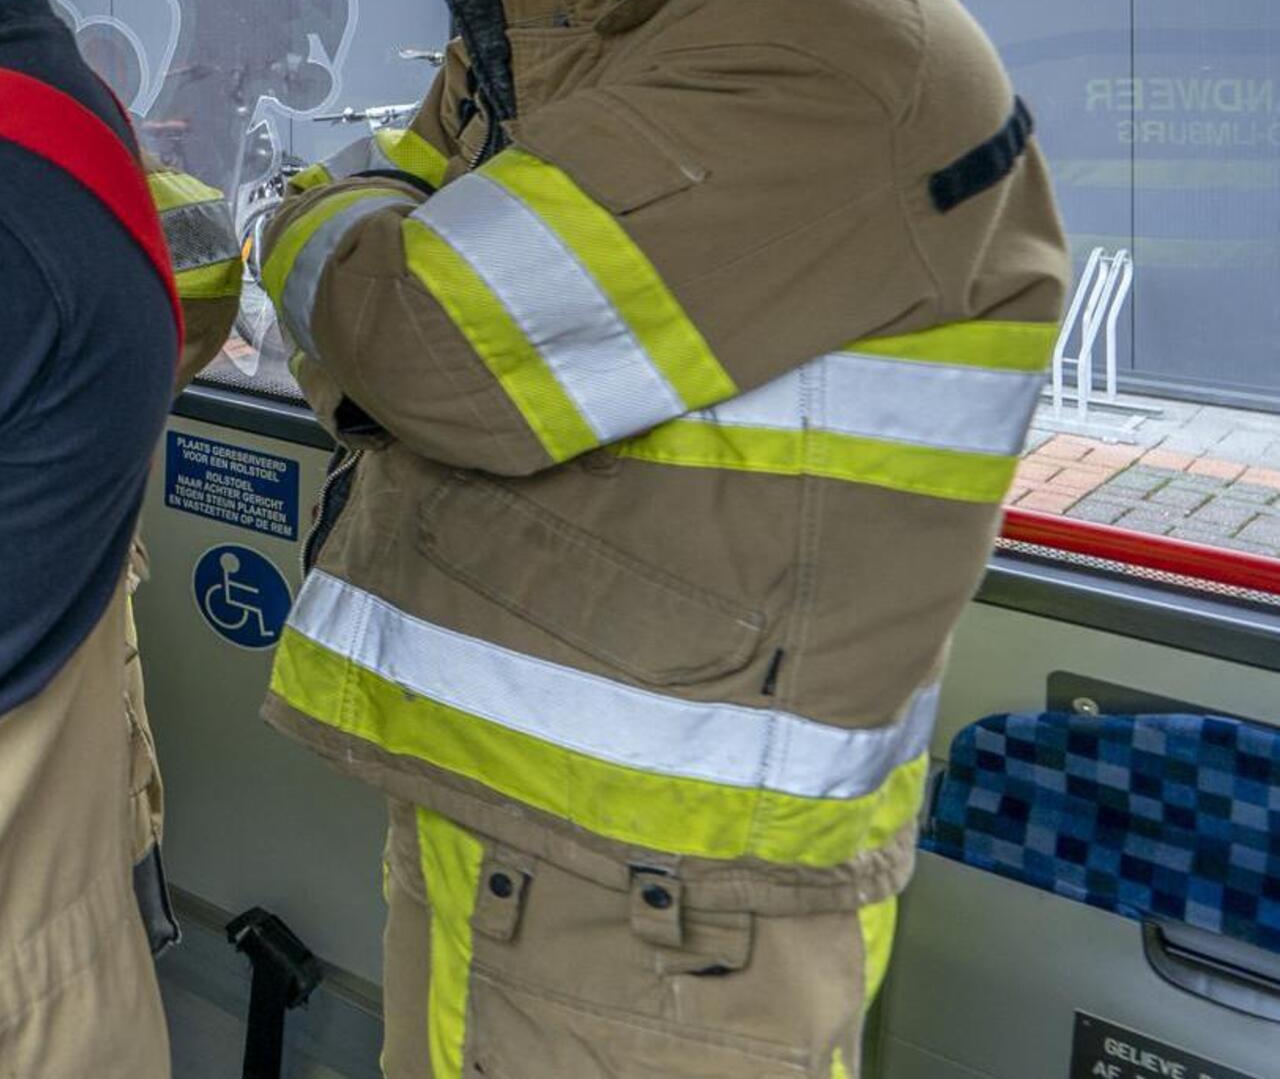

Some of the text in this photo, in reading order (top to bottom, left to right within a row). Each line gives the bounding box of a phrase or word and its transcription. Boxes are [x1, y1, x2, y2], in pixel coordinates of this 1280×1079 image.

[177, 437, 287, 472] PLAATS GERESERVEERD
[182, 450, 280, 483] VOOR EEN ROLSTOEL
[177, 474, 285, 511] NAAR ACHTER GERICHT
[205, 471, 254, 492] ROLSTOEL
[168, 494, 292, 536] EN VASTZETTEN OP DE REM
[175, 484, 287, 523] TEGEN STEUN PLAATSEN
[1103, 1037, 1188, 1079] GELIEVE
